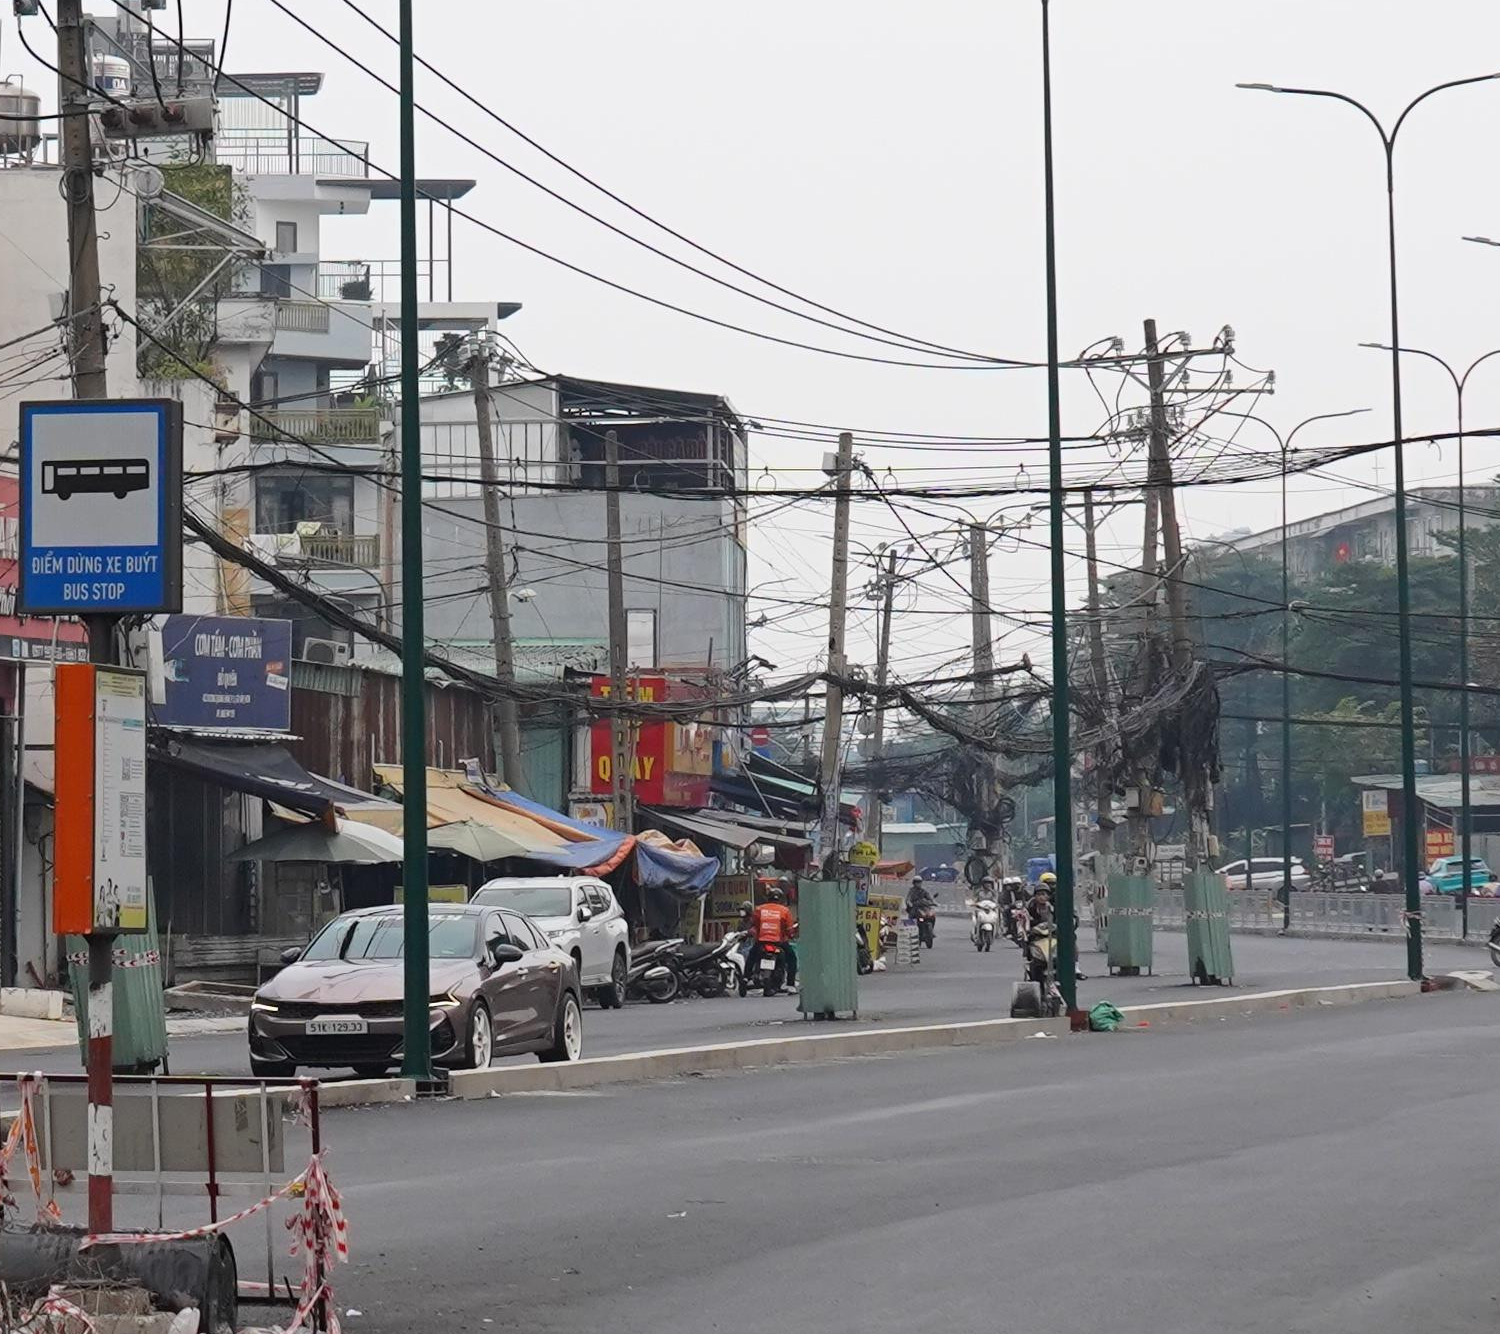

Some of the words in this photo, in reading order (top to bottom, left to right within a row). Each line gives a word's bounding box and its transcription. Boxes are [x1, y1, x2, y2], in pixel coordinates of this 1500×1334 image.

[32, 551, 64, 574] ĐIỂM
[67, 552, 103, 574] DỪNG
[106, 557, 123, 573] XE
[125, 552, 158, 573] BUÝT
[64, 583, 89, 600] BUS
[92, 583, 125, 600] STOP
